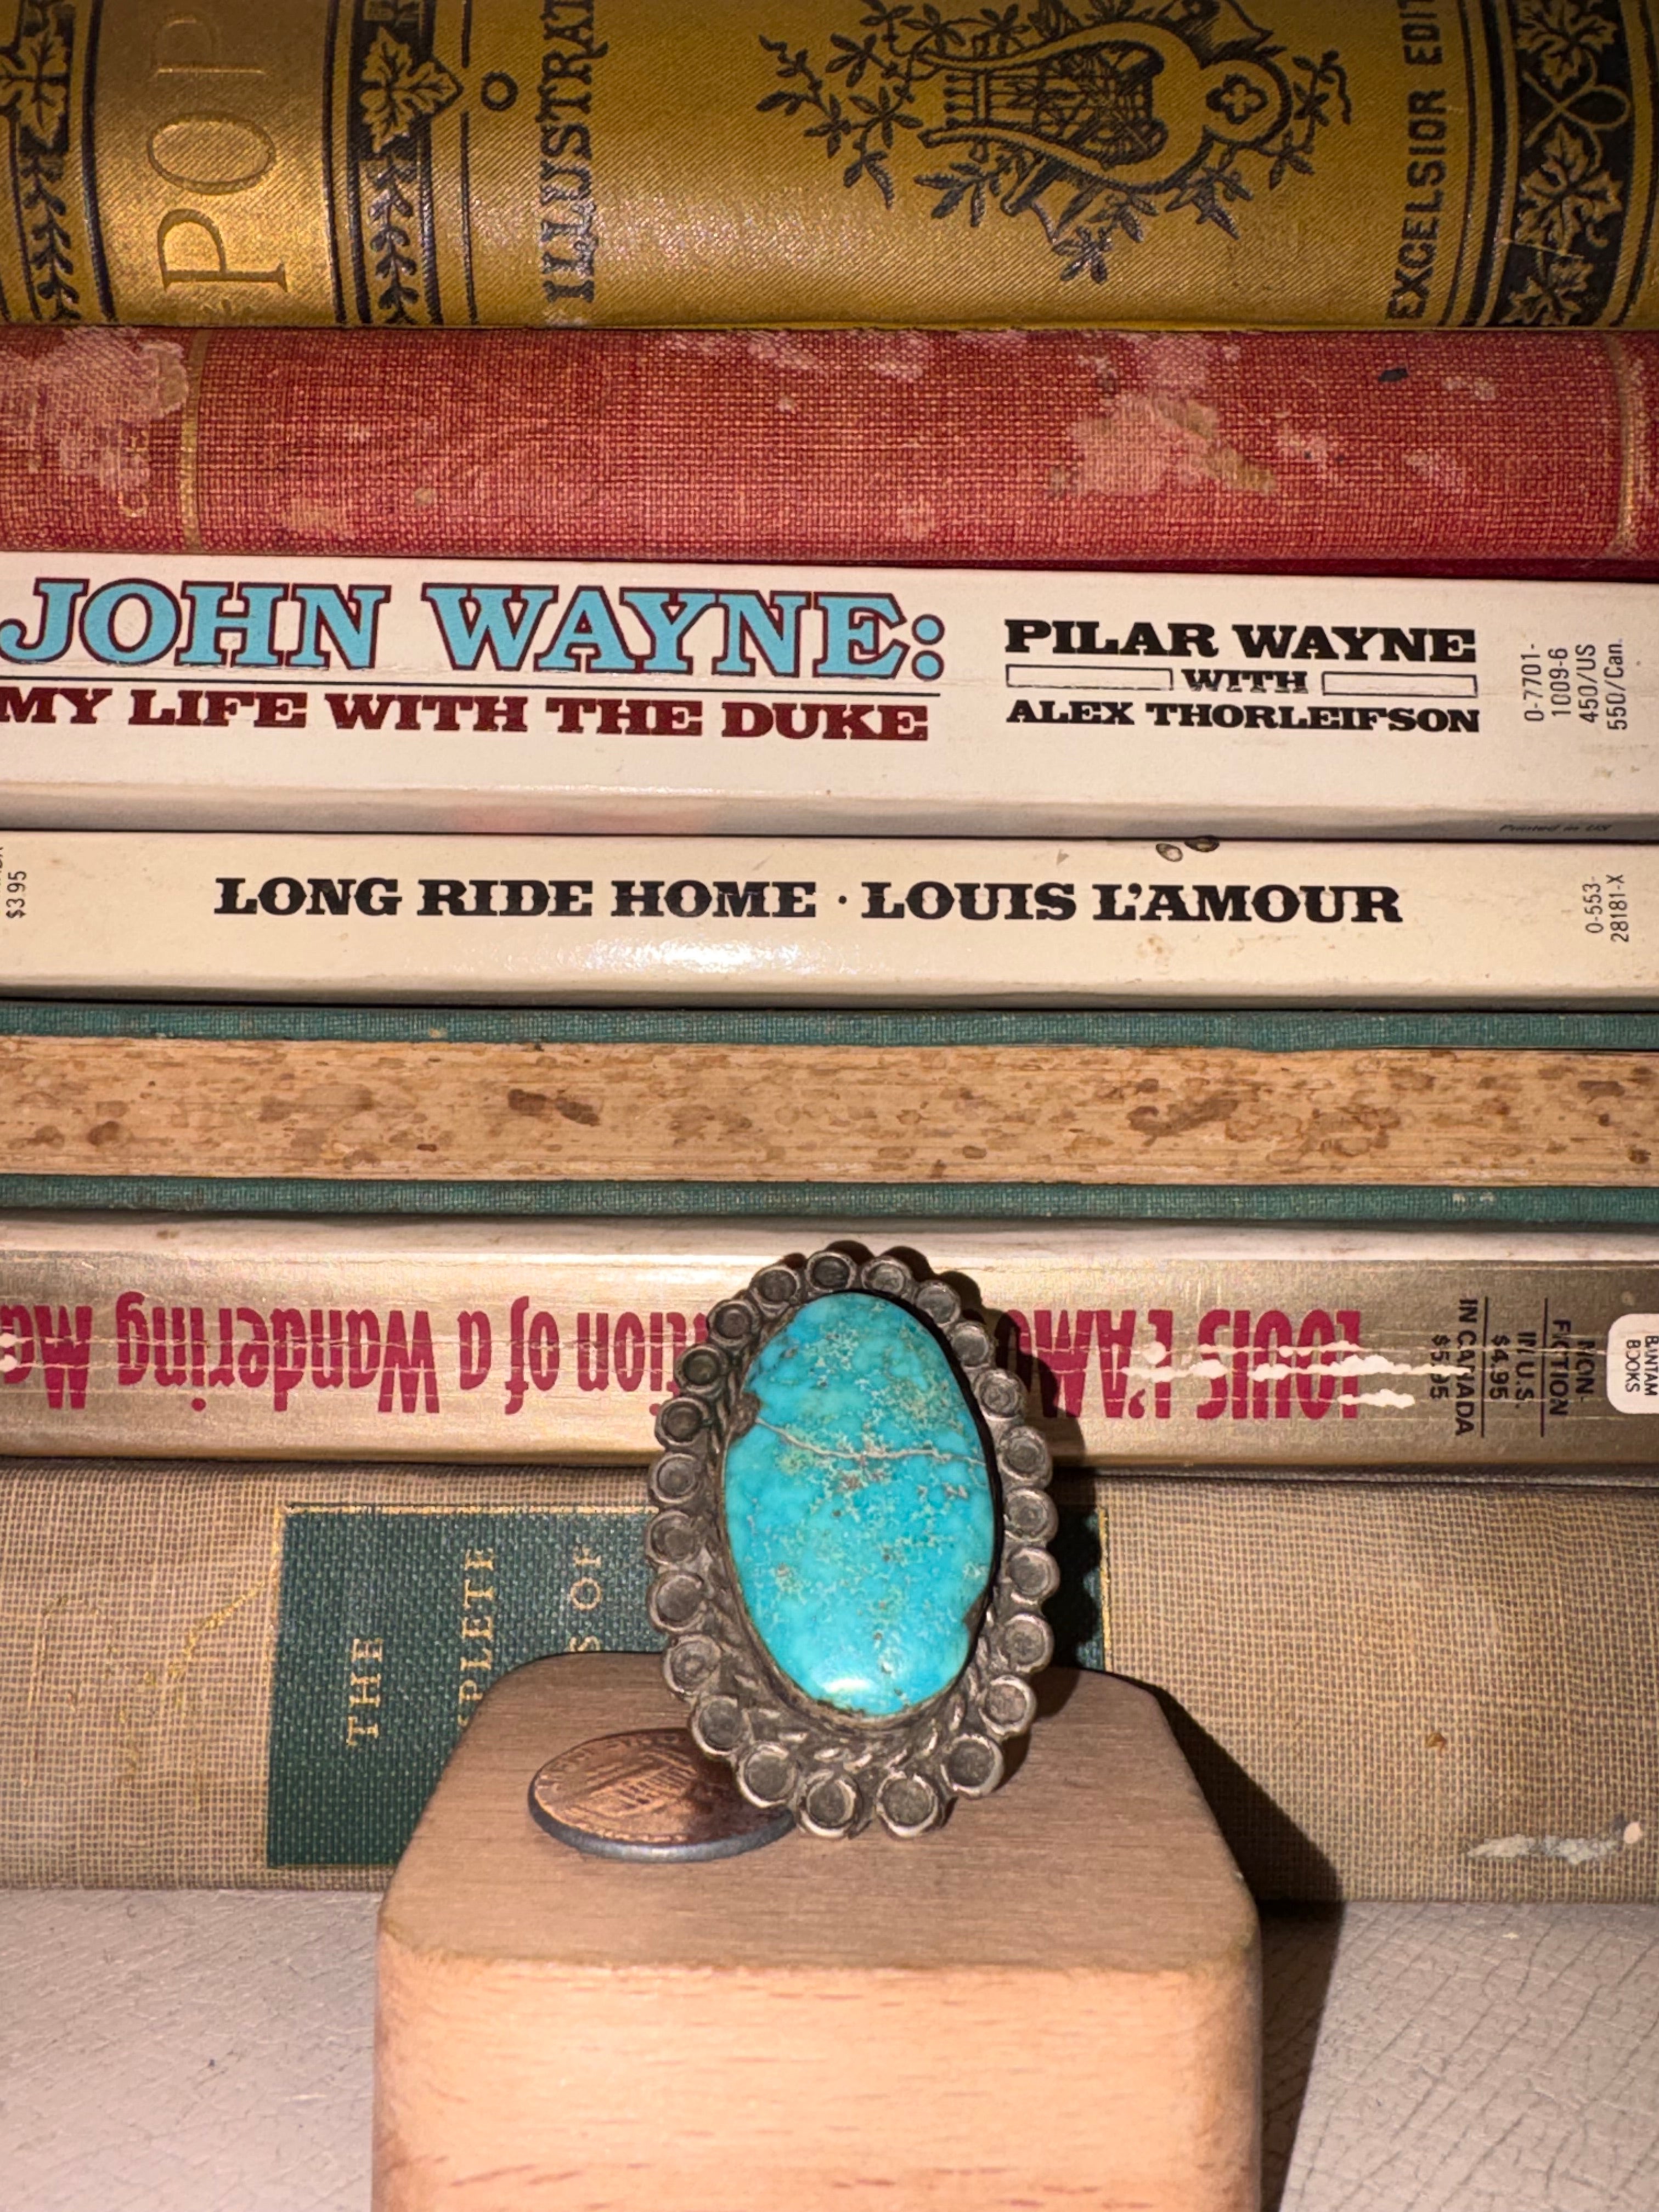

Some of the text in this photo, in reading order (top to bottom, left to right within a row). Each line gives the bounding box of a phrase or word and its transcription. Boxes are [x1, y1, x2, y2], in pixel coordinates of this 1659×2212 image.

[1385, 89, 1447, 320] EXCELSIOR
[0, 577, 945, 681] JOHN WAYNE:
[1005, 619, 1476, 663] PILAR WAYNE
[0, 686, 928, 741] MY LIFE WITH THE DUKE
[1006, 699, 1480, 732] ALEX THORLEIFSON
[1182, 669, 1308, 693] WITH
[1548, 648, 1571, 716] 1009-6
[214, 877, 402, 916] LONG
[417, 879, 593, 917] RIDE
[611, 880, 816, 918] HOME
[861, 881, 1075, 920] LOUIS
[1093, 883, 1403, 922] L'AMOUR
[1606, 874, 1629, 943] 28181-X
[116, 1291, 439, 1414] Wandering
[457, 1310, 491, 1390] a
[505, 1296, 560, 1414] of
[1197, 1309, 1361, 1420] LOUIS
[1455, 1299, 1478, 1436] IN CANADA
[1489, 1335, 1510, 1399] $4.95
[1549, 1320, 1571, 1415] FICTION
[458, 1547, 495, 1726] PLETE
[346, 1638, 383, 1746] THE
